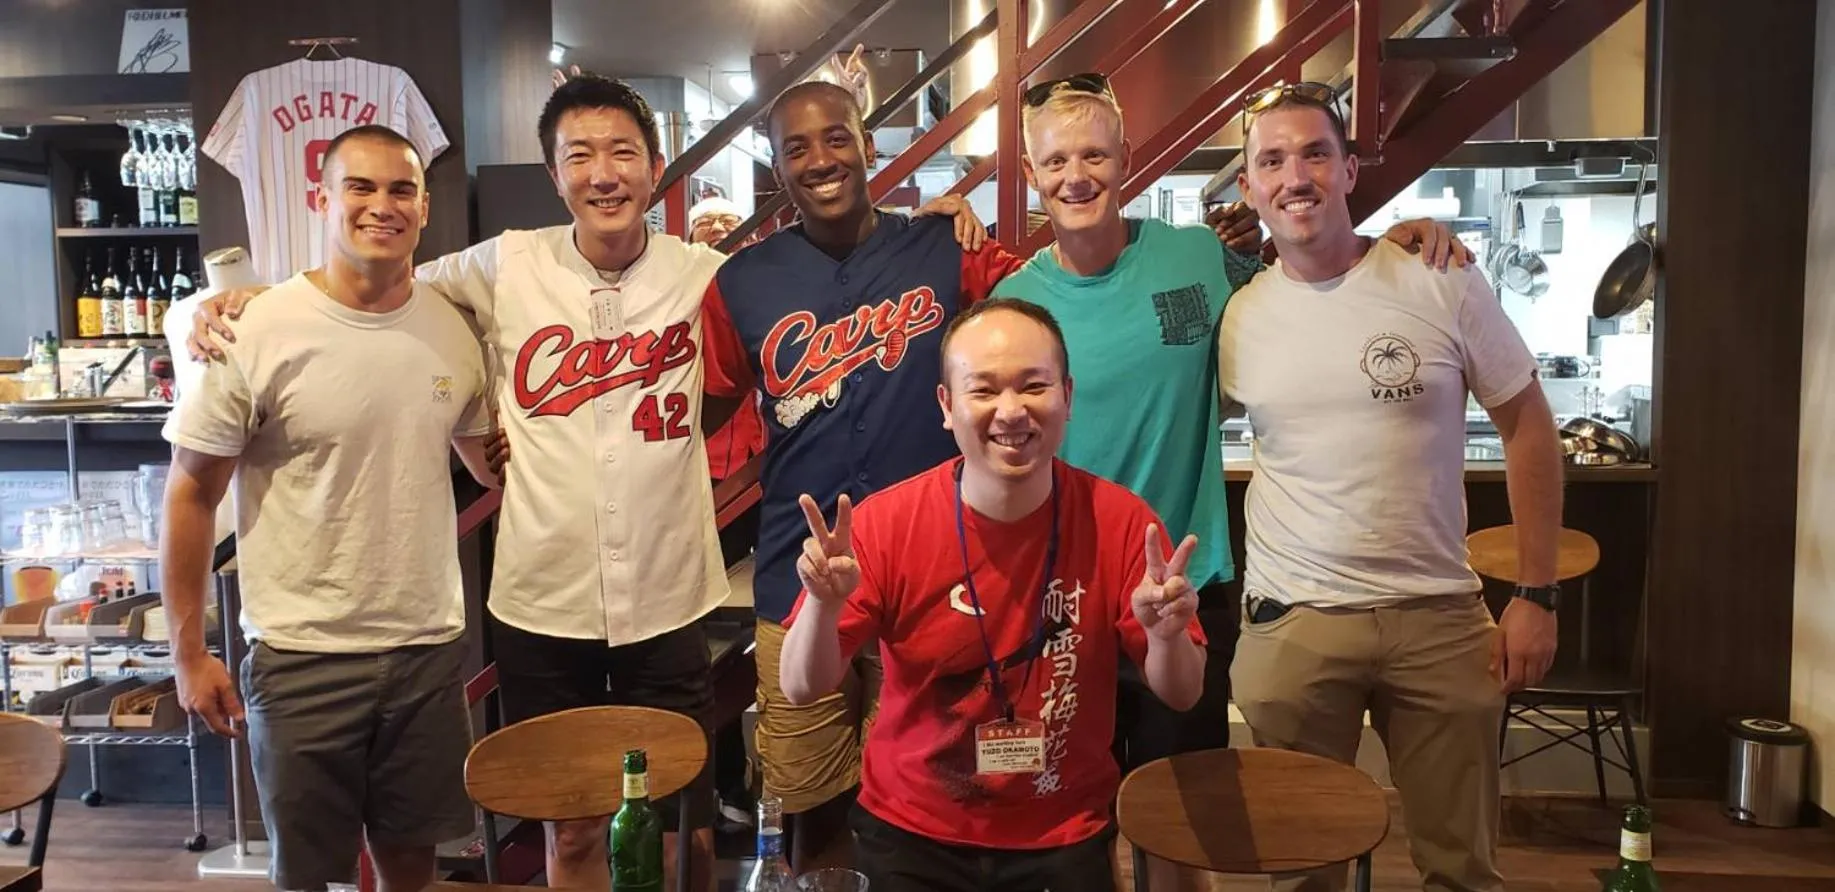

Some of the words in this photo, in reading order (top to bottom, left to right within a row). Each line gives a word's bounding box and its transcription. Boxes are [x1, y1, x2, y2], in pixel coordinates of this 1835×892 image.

[273, 91, 378, 132] OGATA
[760, 285, 945, 400] Carp
[513, 320, 697, 419] Carp
[1371, 384, 1424, 399] VANS
[632, 393, 692, 442] 42
[988, 728, 1030, 737] STAFF
